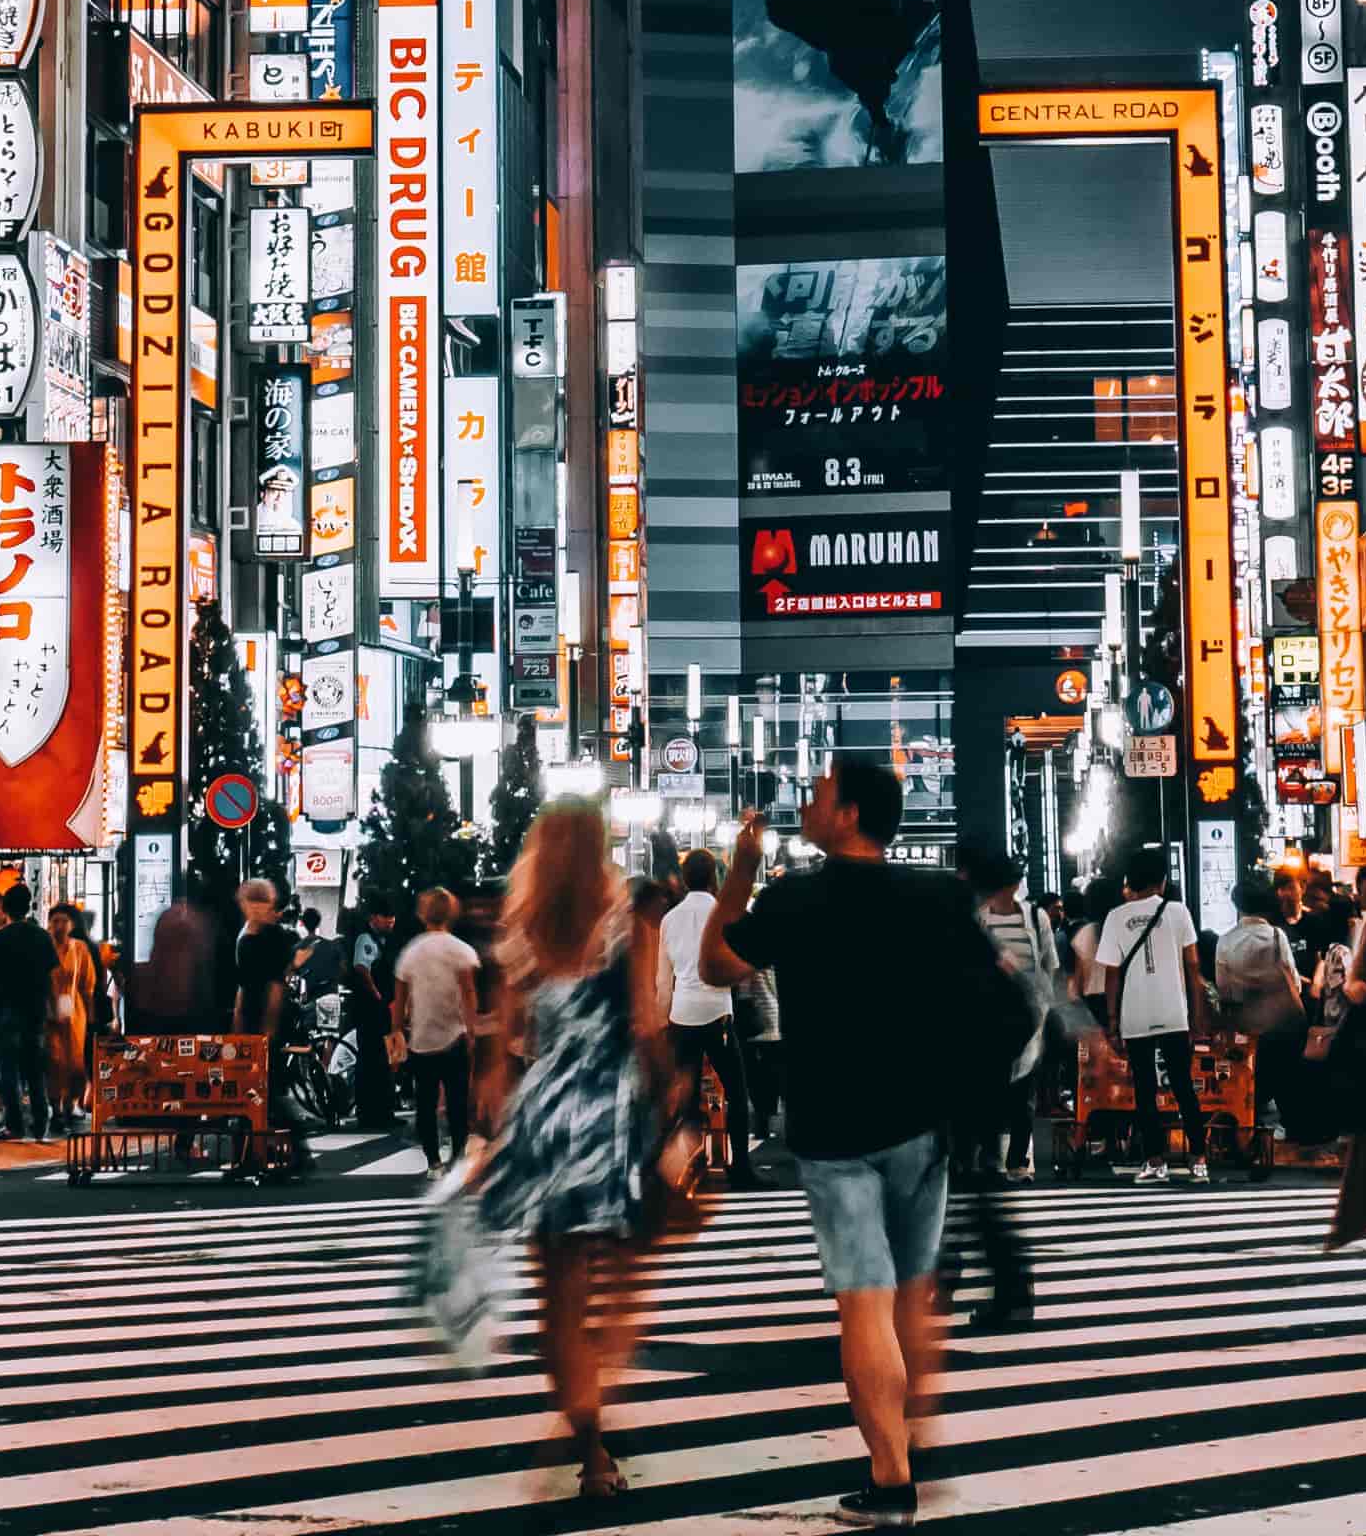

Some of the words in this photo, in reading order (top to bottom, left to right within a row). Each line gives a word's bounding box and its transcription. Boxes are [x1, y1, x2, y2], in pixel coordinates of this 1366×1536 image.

[389, 37, 427, 121] BIC
[1313, 50, 1333, 67] 5F
[989, 102, 1105, 123] CENTRAL
[1113, 100, 1181, 121] ROAD
[1305, 101, 1342, 203] Booth
[0, 113, 22, 215] とらそば
[389, 136, 427, 278] DRUG
[398, 303, 418, 345] BIC
[141, 211, 174, 525] GODZILLA
[398, 349, 418, 442] CAMERA
[1311, 327, 1356, 441] 甘太郎
[262, 377, 294, 462] 海の家
[784, 404, 902, 426] フォールアウト
[1185, 233, 1226, 664] ゴジラロード
[39, 449, 68, 554] 大衆酒場
[398, 457, 418, 554] SHIDAX
[824, 457, 862, 487] 8.3
[1319, 454, 1353, 474] 4F
[1321, 478, 1353, 497] 3F
[809, 529, 940, 567] MARUHAN
[515, 584, 556, 600] Cafe
[138, 565, 172, 715] ROAD
